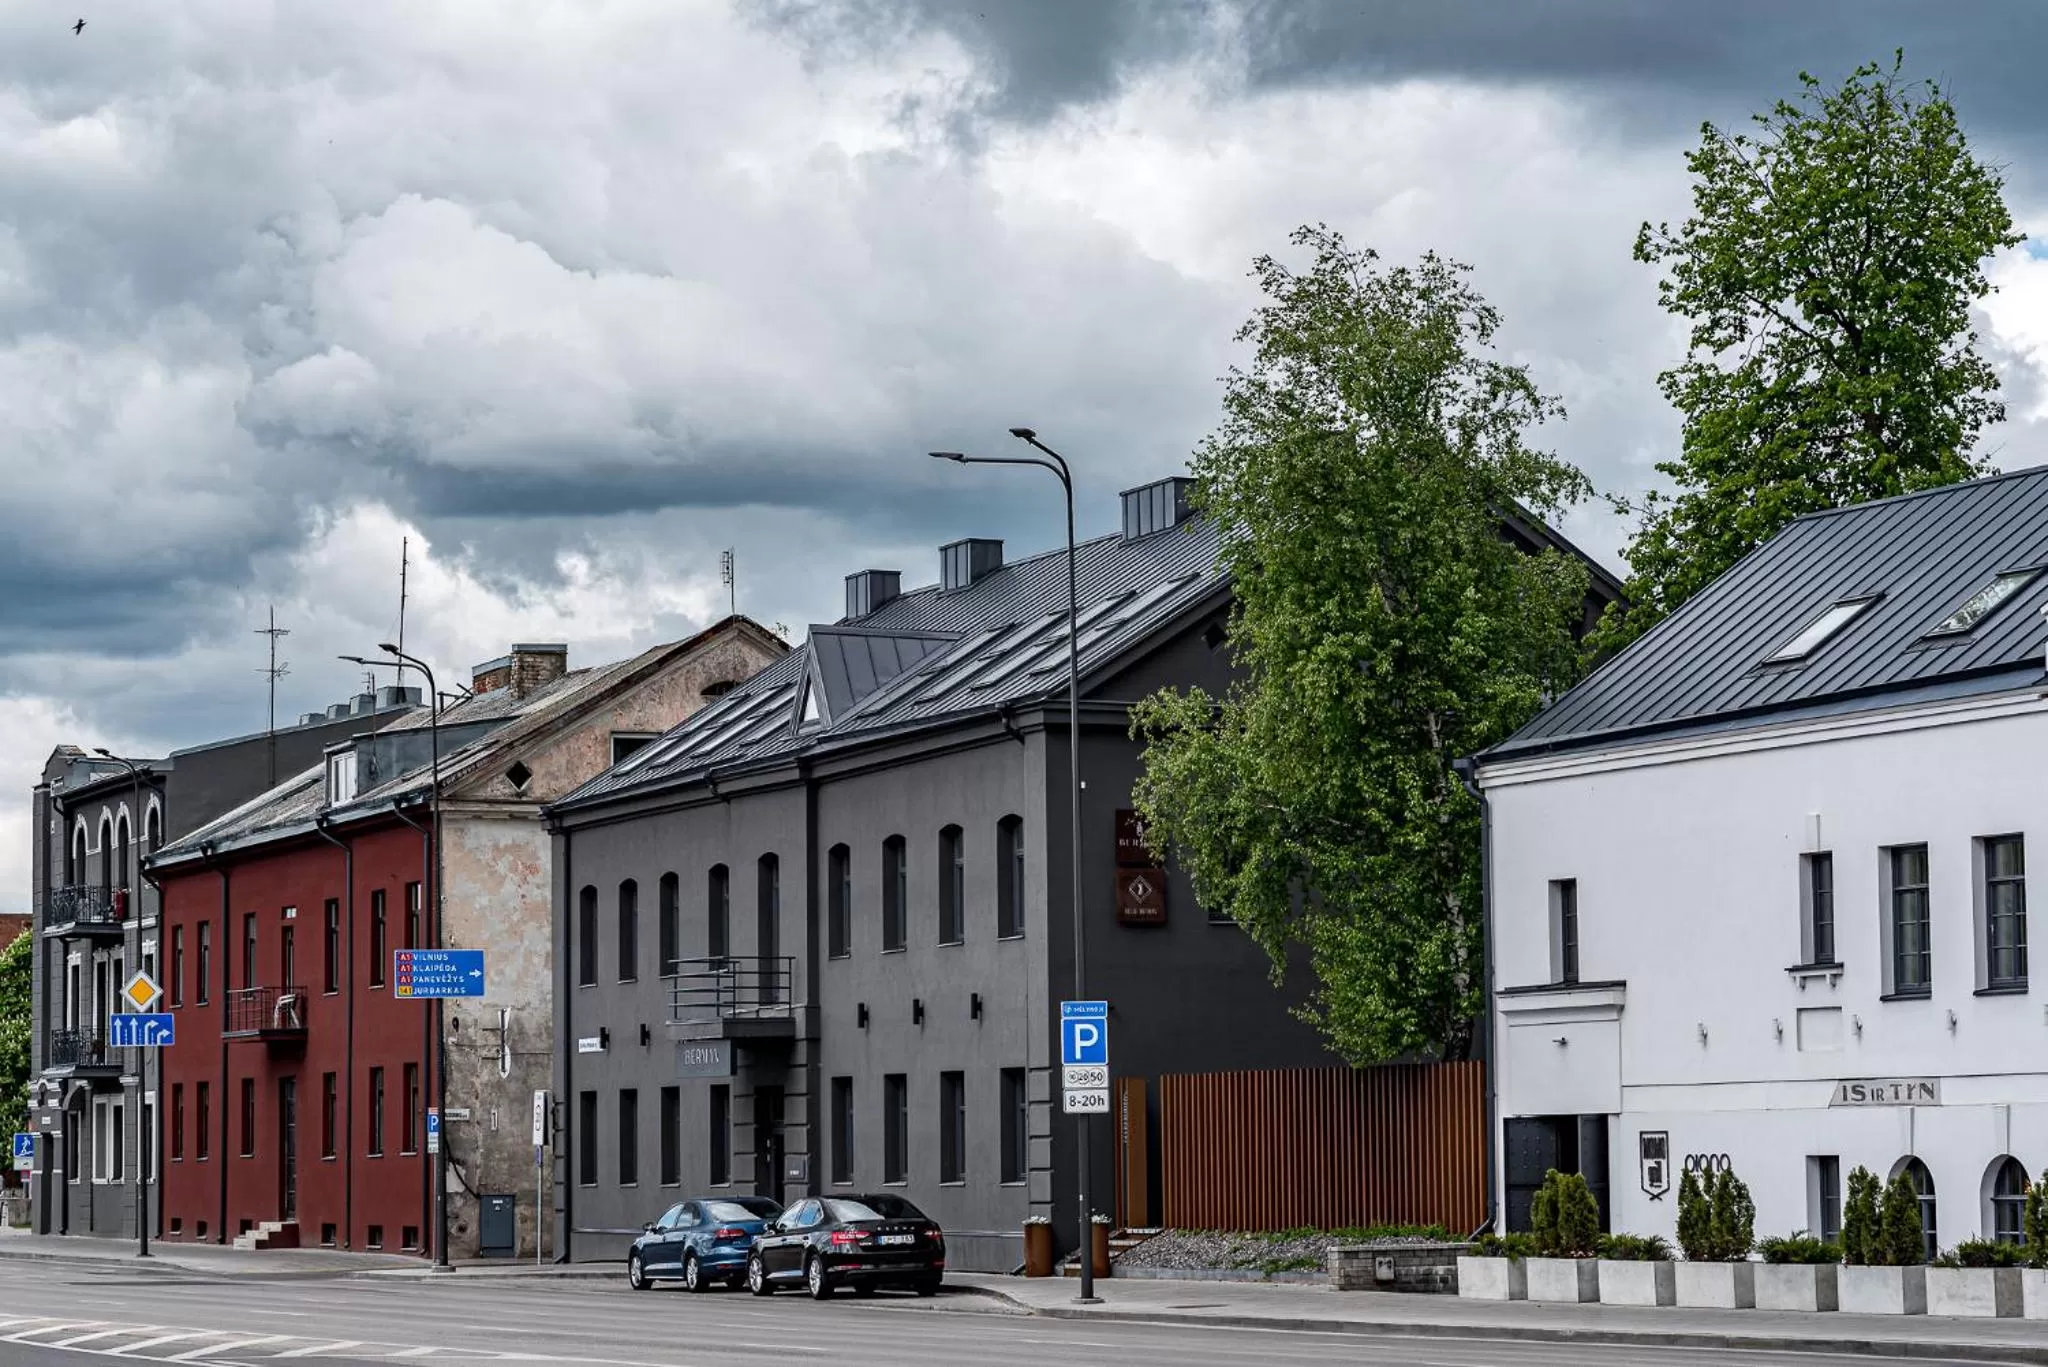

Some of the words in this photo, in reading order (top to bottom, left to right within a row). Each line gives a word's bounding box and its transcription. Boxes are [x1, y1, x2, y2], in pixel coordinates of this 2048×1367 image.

[413, 953, 449, 961] VILNIUS
[1075, 1023, 1099, 1060] P
[1090, 1071, 1103, 1082] 50
[1069, 1095, 1105, 1109] 8-20h
[431, 1115, 438, 1130] P
